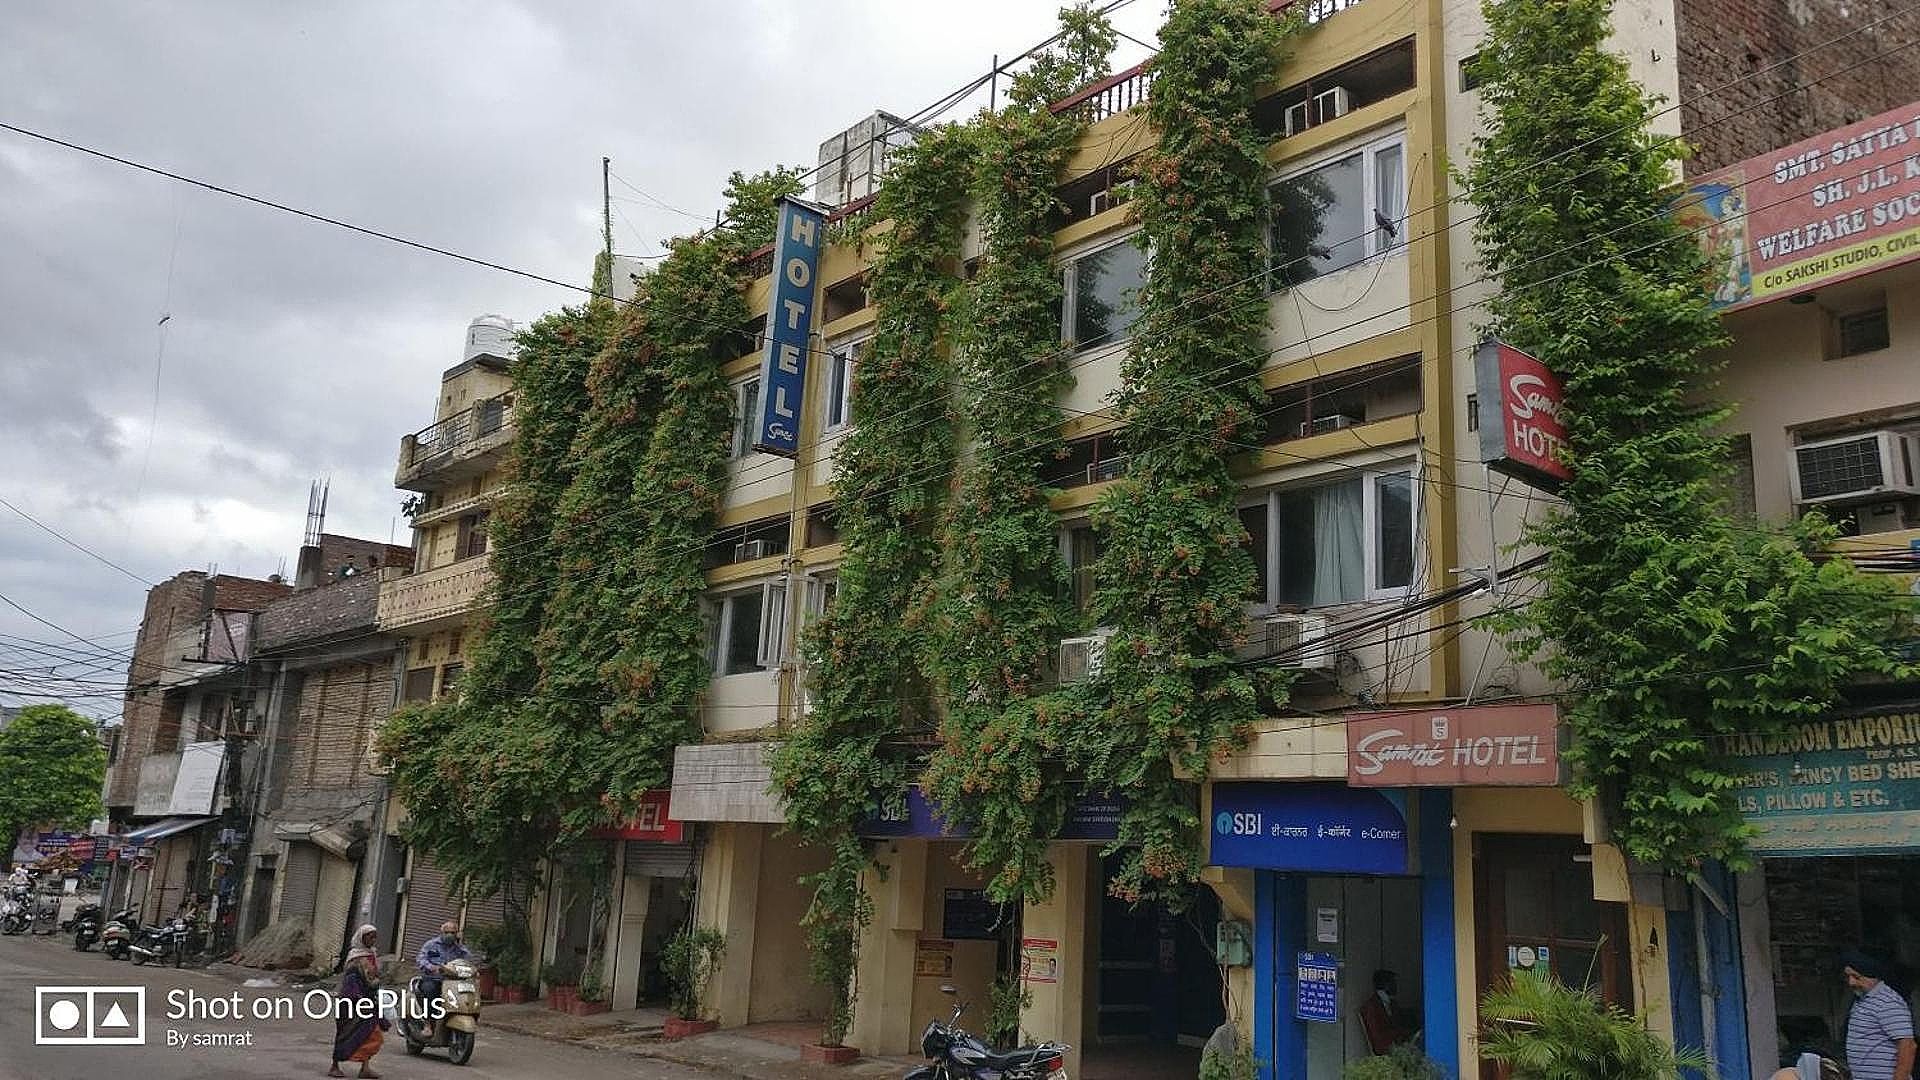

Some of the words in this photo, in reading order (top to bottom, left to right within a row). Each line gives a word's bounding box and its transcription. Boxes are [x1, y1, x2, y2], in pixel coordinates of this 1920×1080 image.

[1812, 177, 1851, 208] SH.
[1757, 208, 1867, 261] WELFARE
[1764, 274, 1783, 289] C/o
[1785, 259, 1829, 283] SAKSHI
[1832, 244, 1883, 269] STUDIO,
[774, 213, 816, 419] HOTEL
[1452, 735, 1547, 767] HOTEL
[1848, 763, 1883, 782] BED
[1766, 791, 1827, 811] PILLOW
[1833, 791, 1845, 808] &
[1851, 788, 1890, 808] ETC.
[1233, 812, 1262, 835] SBI
[1361, 827, 1401, 840] e-Corner
